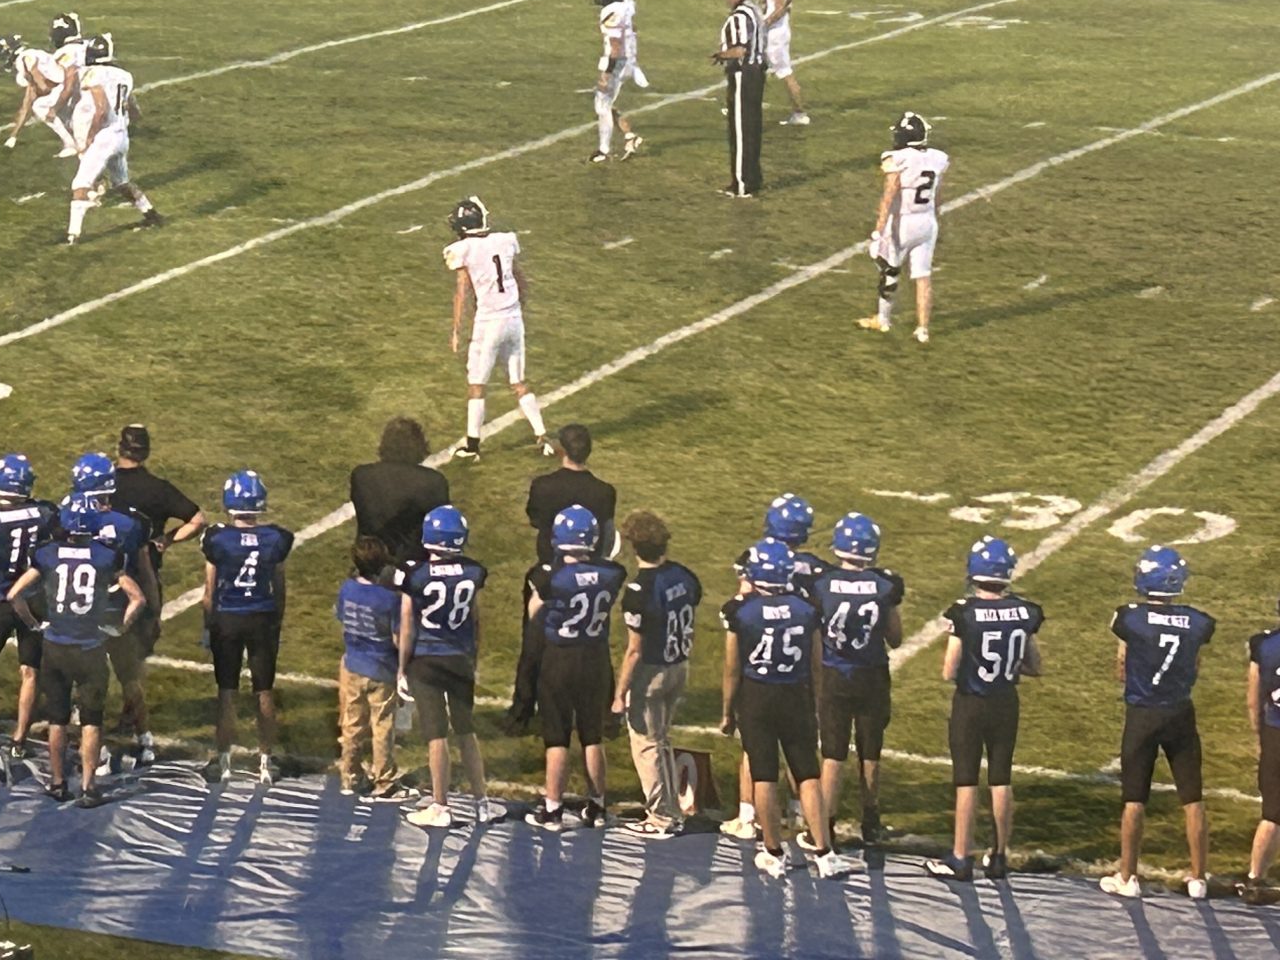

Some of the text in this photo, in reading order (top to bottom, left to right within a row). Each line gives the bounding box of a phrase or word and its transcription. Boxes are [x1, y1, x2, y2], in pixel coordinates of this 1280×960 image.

[914, 170, 936, 204] 2
[492, 254, 505, 293] 1
[54, 563, 97, 615] 19
[234, 550, 260, 597] 4
[421, 579, 475, 630] 28
[558, 590, 611, 638] 26
[827, 601, 879, 650] 43
[748, 625, 804, 675] 45
[977, 628, 1027, 682] 50
[1152, 633, 1180, 685] 7
